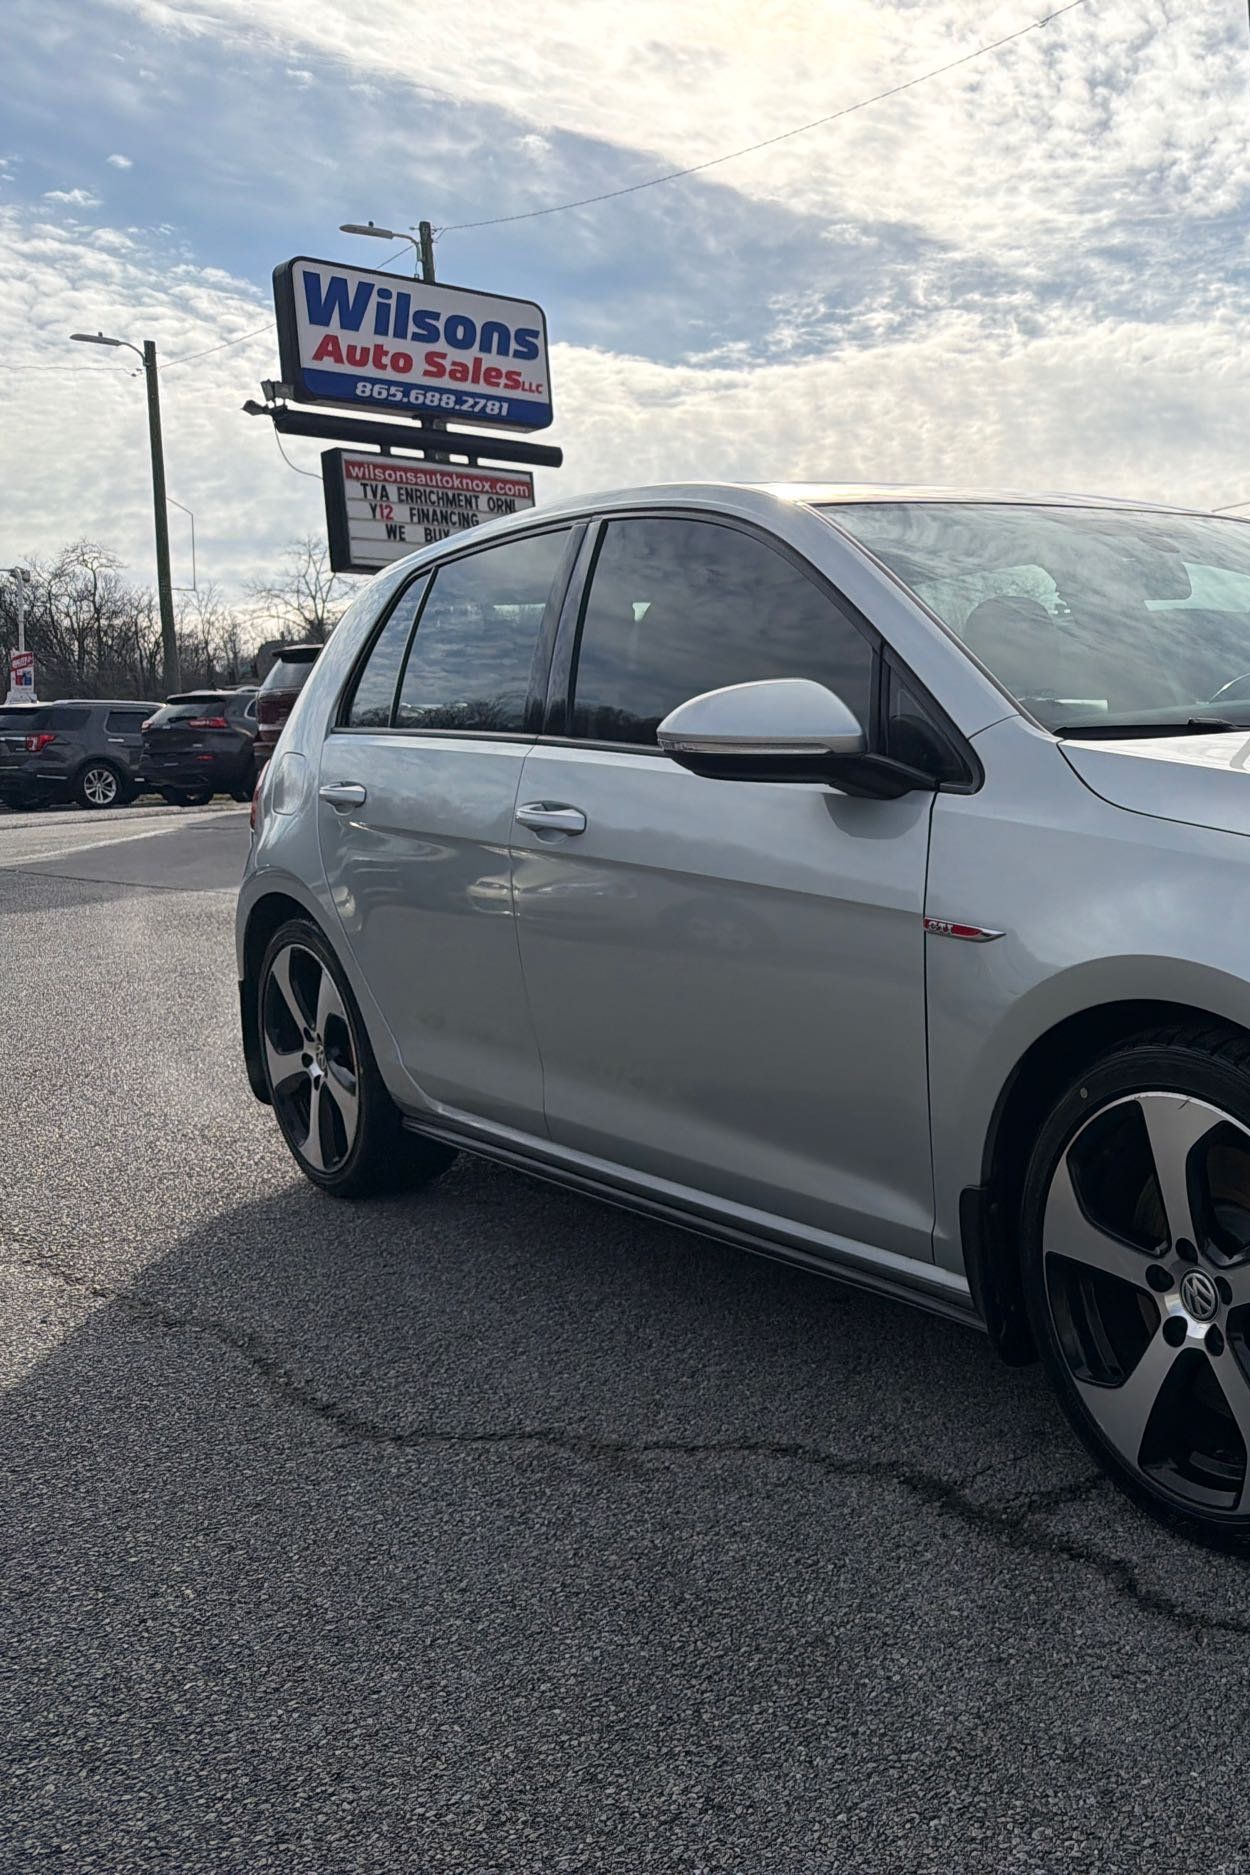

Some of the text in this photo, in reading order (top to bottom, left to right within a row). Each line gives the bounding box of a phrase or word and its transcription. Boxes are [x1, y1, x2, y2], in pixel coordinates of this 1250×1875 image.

[303, 270, 540, 360] Wilsons
[312, 334, 543, 394] Auto Sales LLC
[355, 382, 509, 416] 865.688.2781
[349, 465, 529, 497] wilsonsautoknox.com
[360, 482, 390, 501] TVA
[397, 486, 479, 510] ENRICHMENT
[369, 502, 479, 528] Y12 FINANCING
[385, 523, 406, 542] WE
[928, 920, 953, 935] GTI
